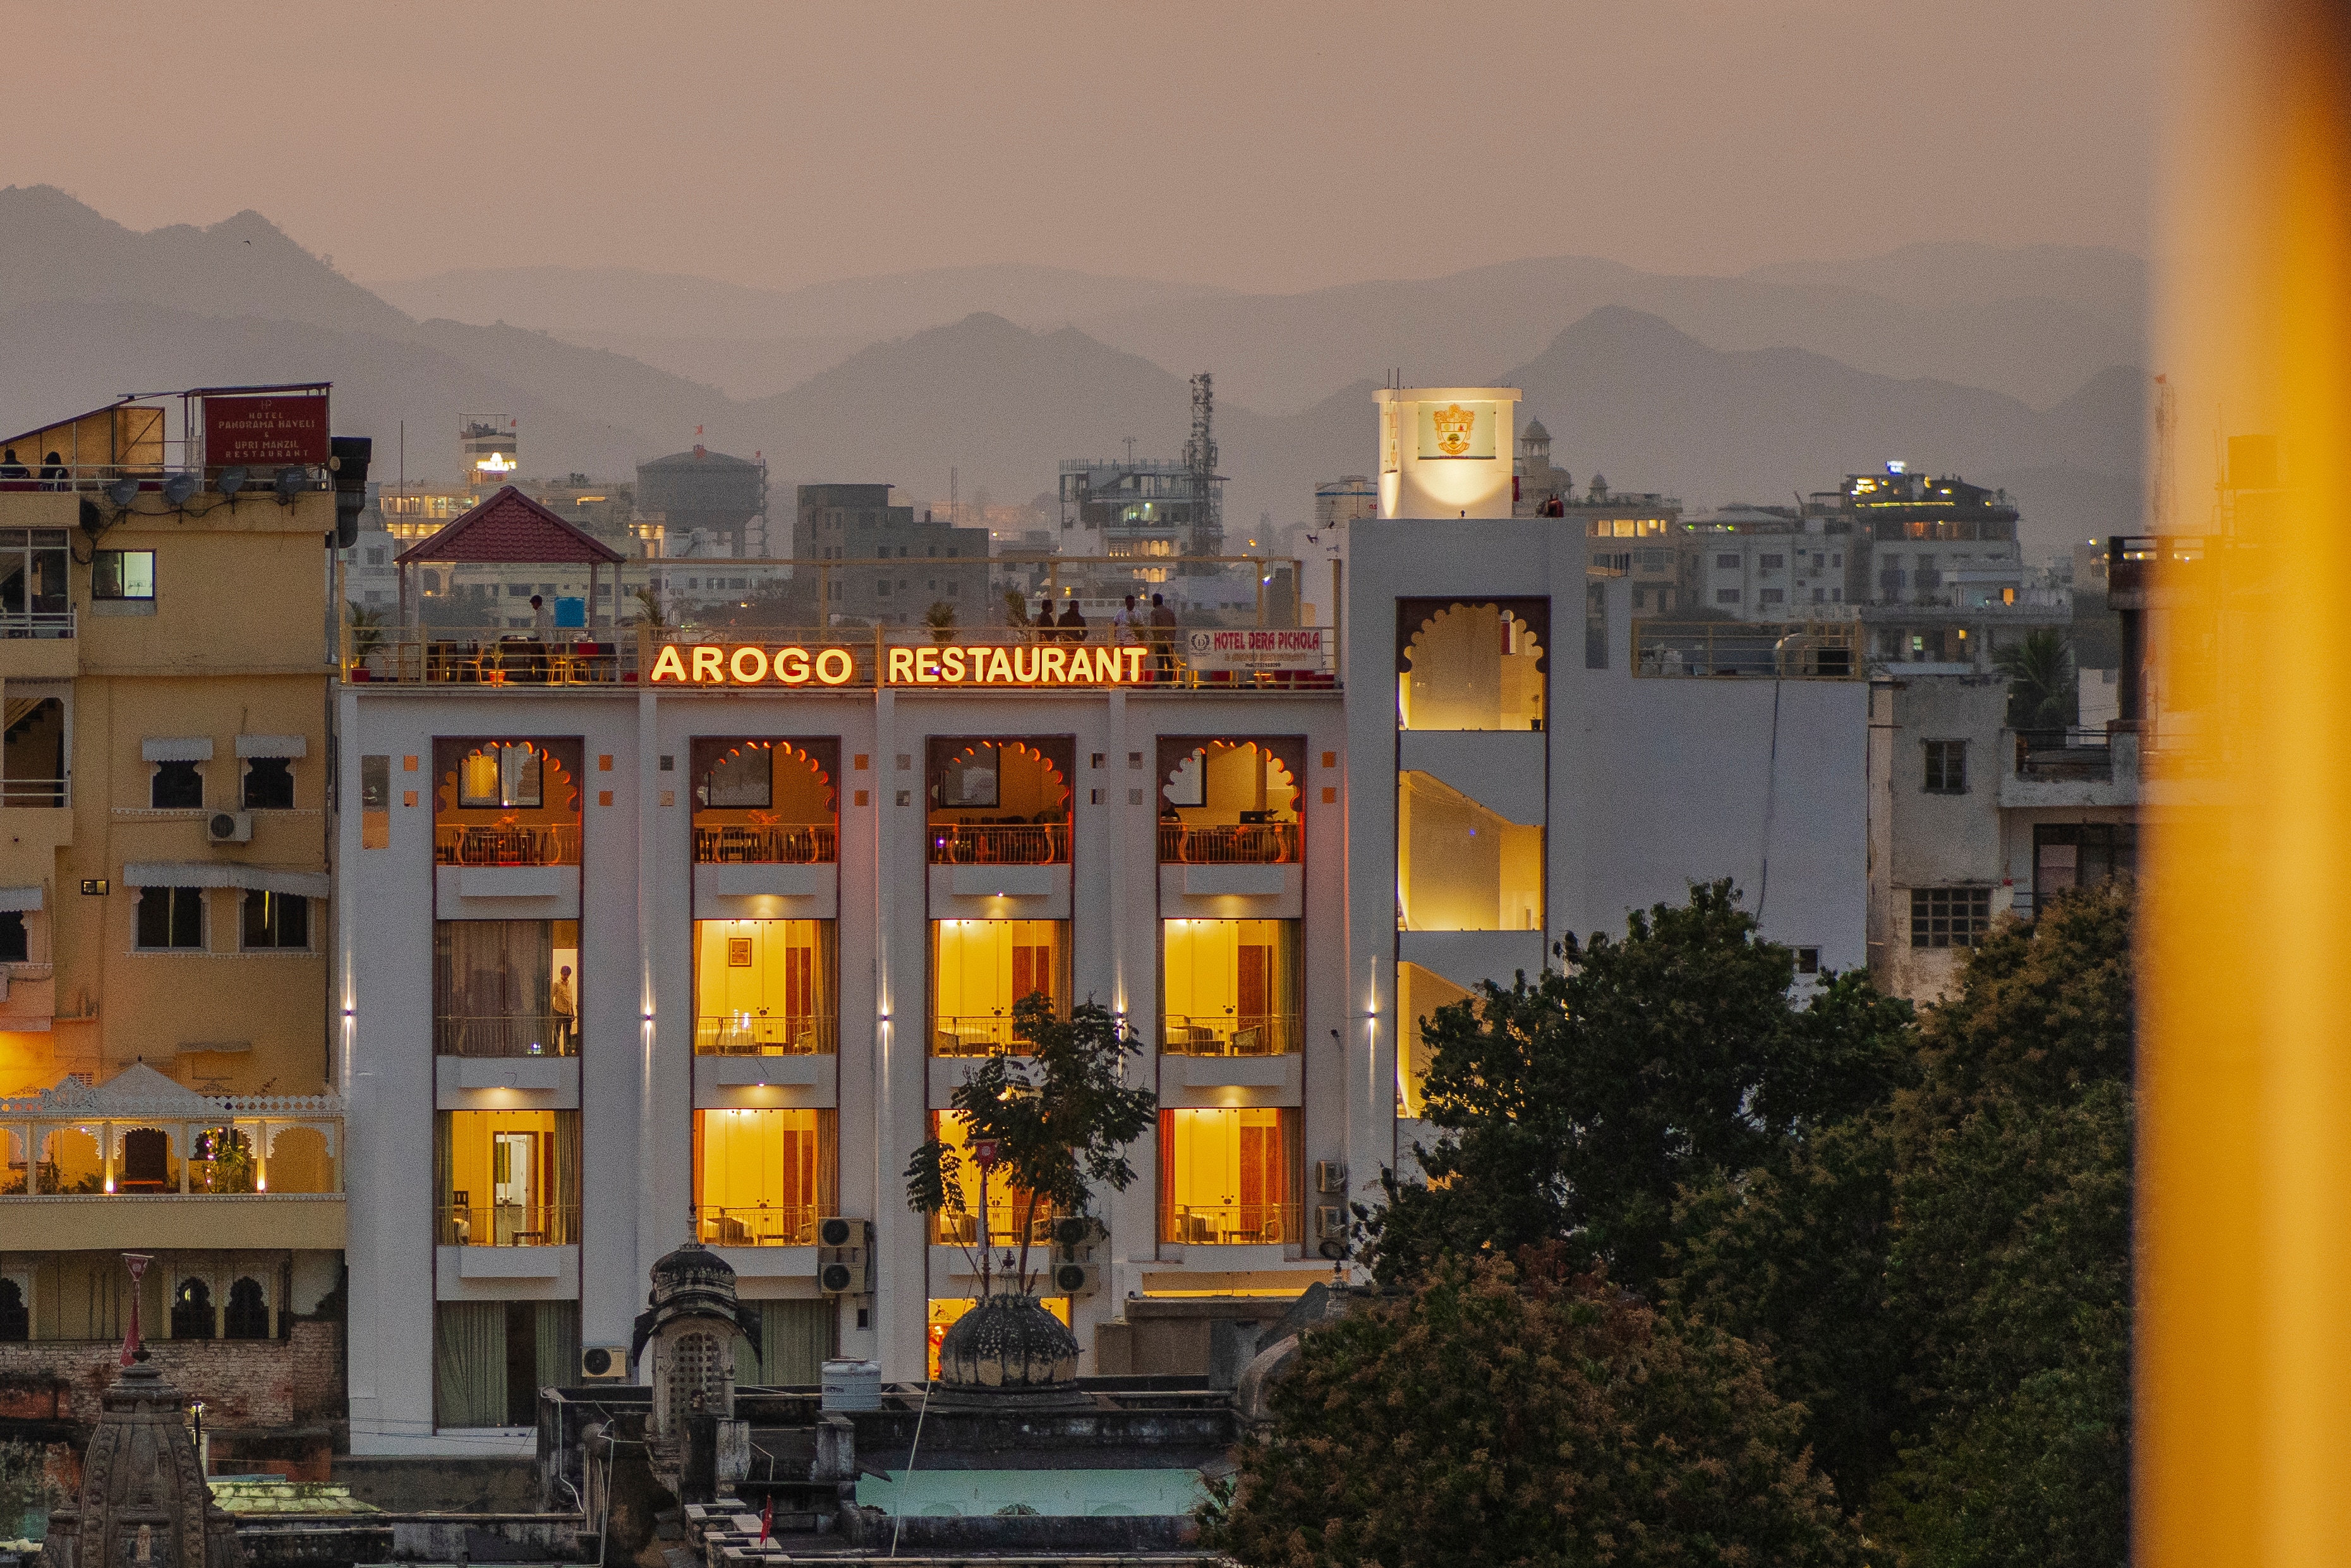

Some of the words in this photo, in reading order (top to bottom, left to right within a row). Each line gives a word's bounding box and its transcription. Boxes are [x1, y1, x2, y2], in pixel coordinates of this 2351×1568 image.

[219, 421, 274, 429] PANORAMA
[279, 420, 315, 428] HAVELI
[235, 441, 258, 449] UPRI
[262, 440, 299, 449] MANZIL
[226, 450, 308, 458] RESTAURANT
[1214, 632, 1245, 651] HOTEL
[1248, 632, 1275, 651] DERA
[1278, 632, 1319, 651] PICHOLA
[651, 646, 852, 684] AROGO
[889, 647, 1147, 683] RESTAURANT
